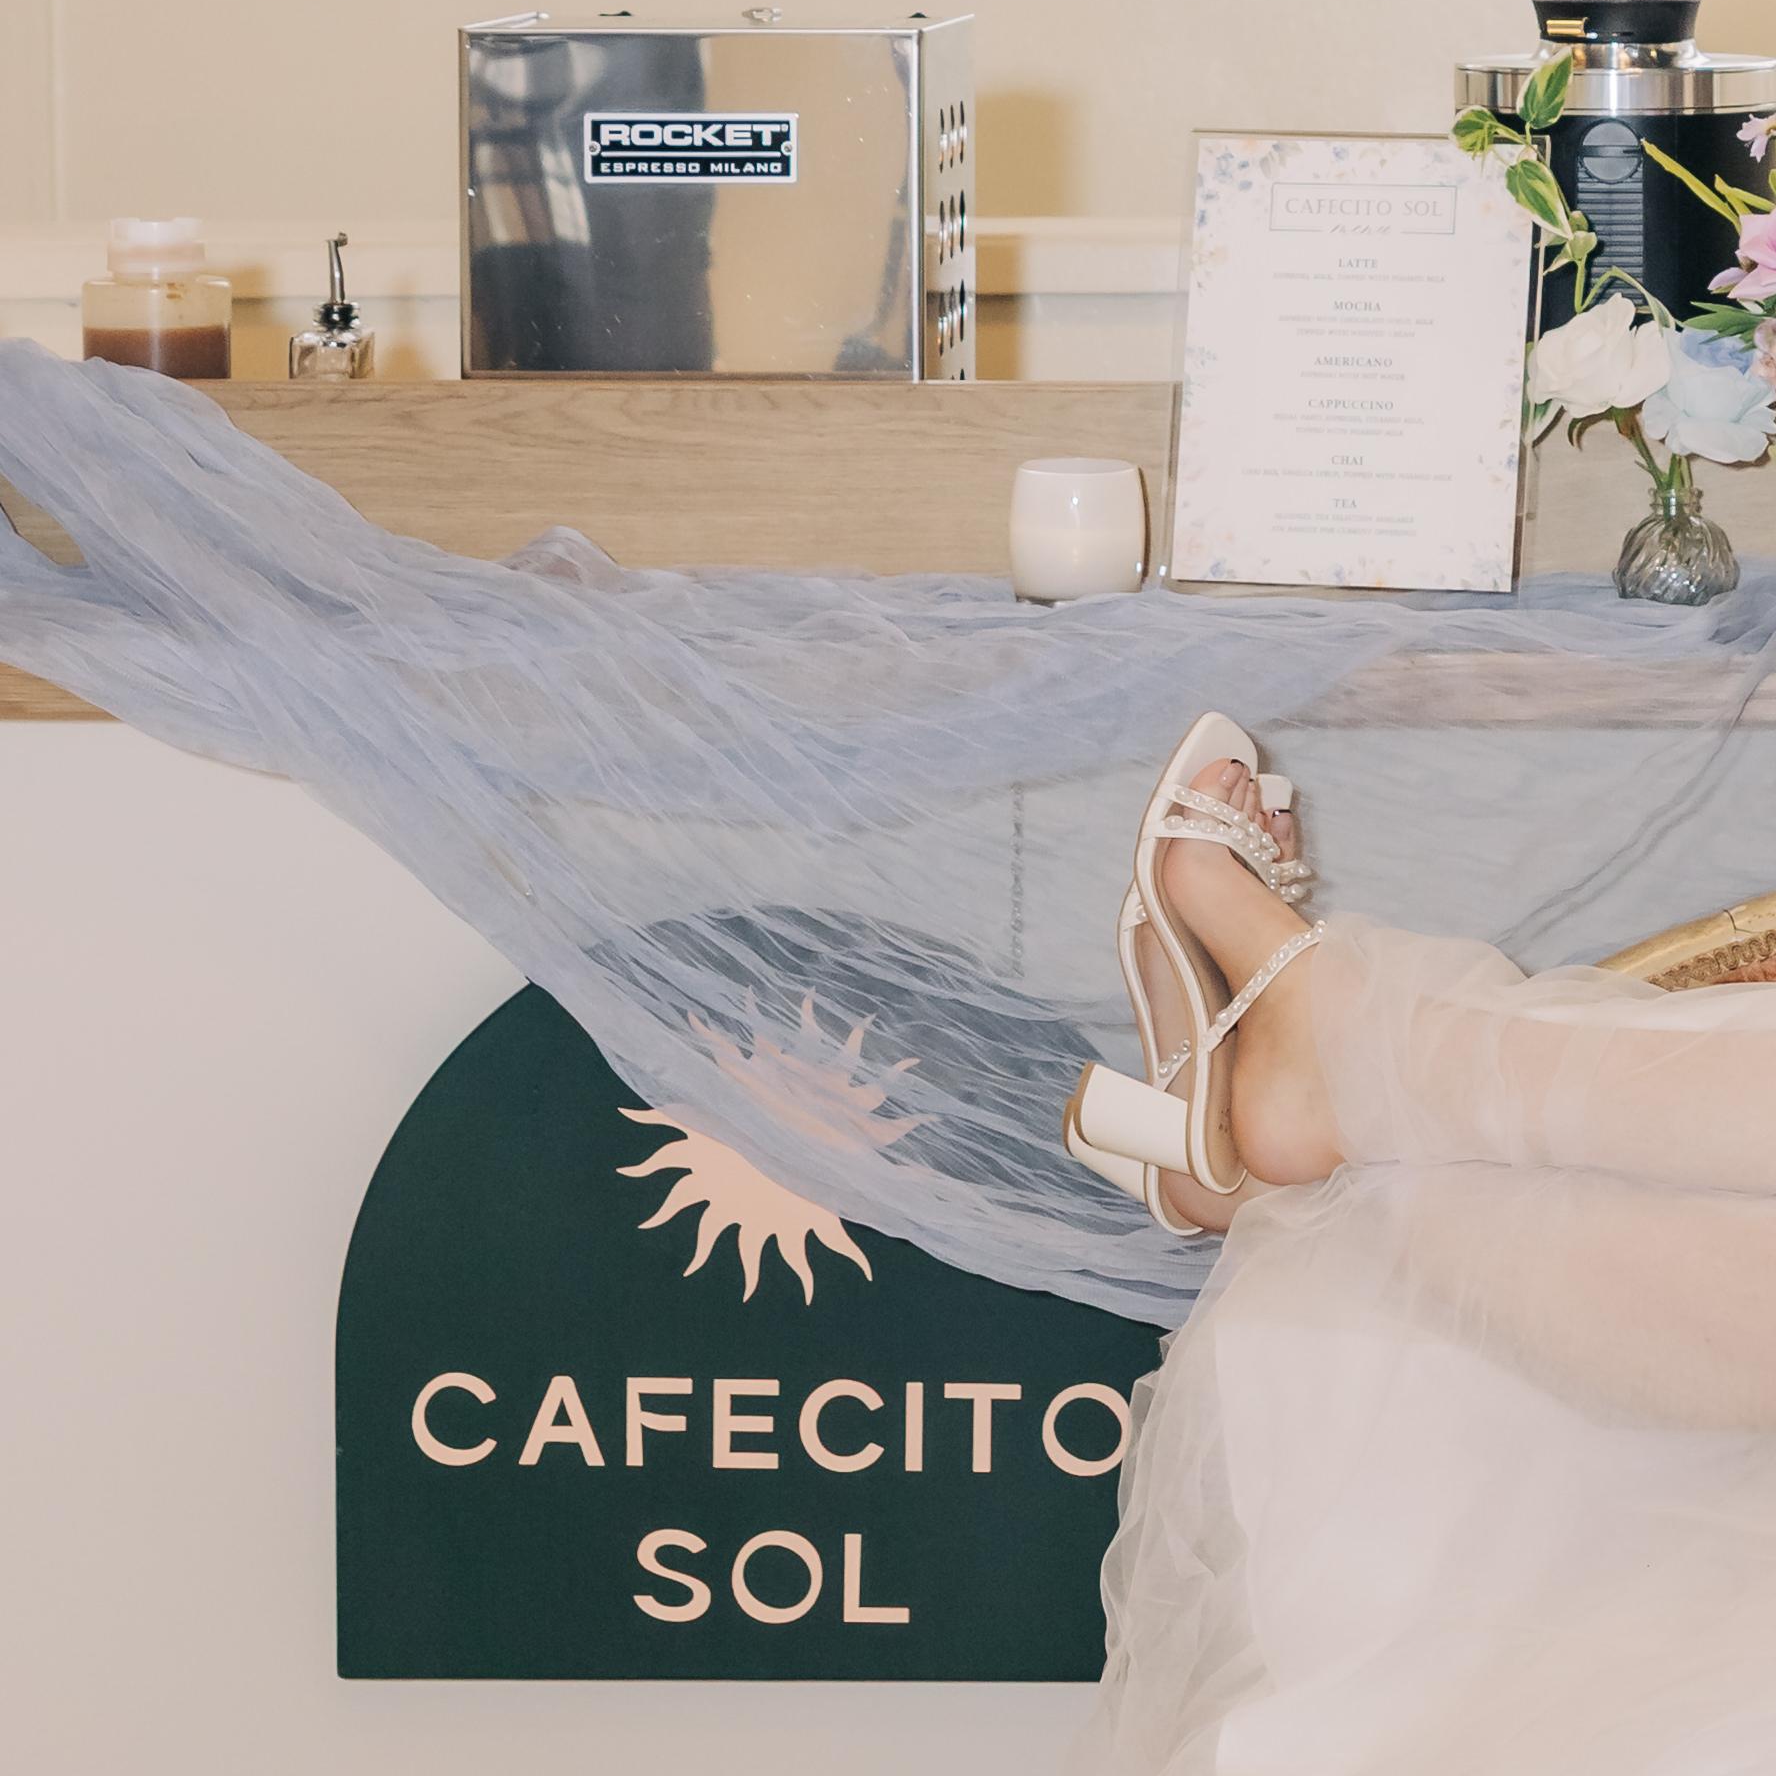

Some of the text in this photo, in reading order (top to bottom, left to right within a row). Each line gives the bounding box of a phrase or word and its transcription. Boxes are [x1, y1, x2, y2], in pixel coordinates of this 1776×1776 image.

[599, 162, 782, 174] ESPRESSO MILANO
[1284, 198, 1443, 217] CAFECITO SOL
[1338, 258, 1379, 269] LATTE
[1332, 300, 1382, 312] MOCHA
[1313, 356, 1394, 368] AMERICANO
[1307, 398, 1395, 411] CAPPUCCINO
[1330, 455, 1365, 466] CHAI
[1332, 498, 1358, 509] TEA
[411, 1372, 1131, 1477] CAFECITO
[633, 1528, 910, 1624] SOL
